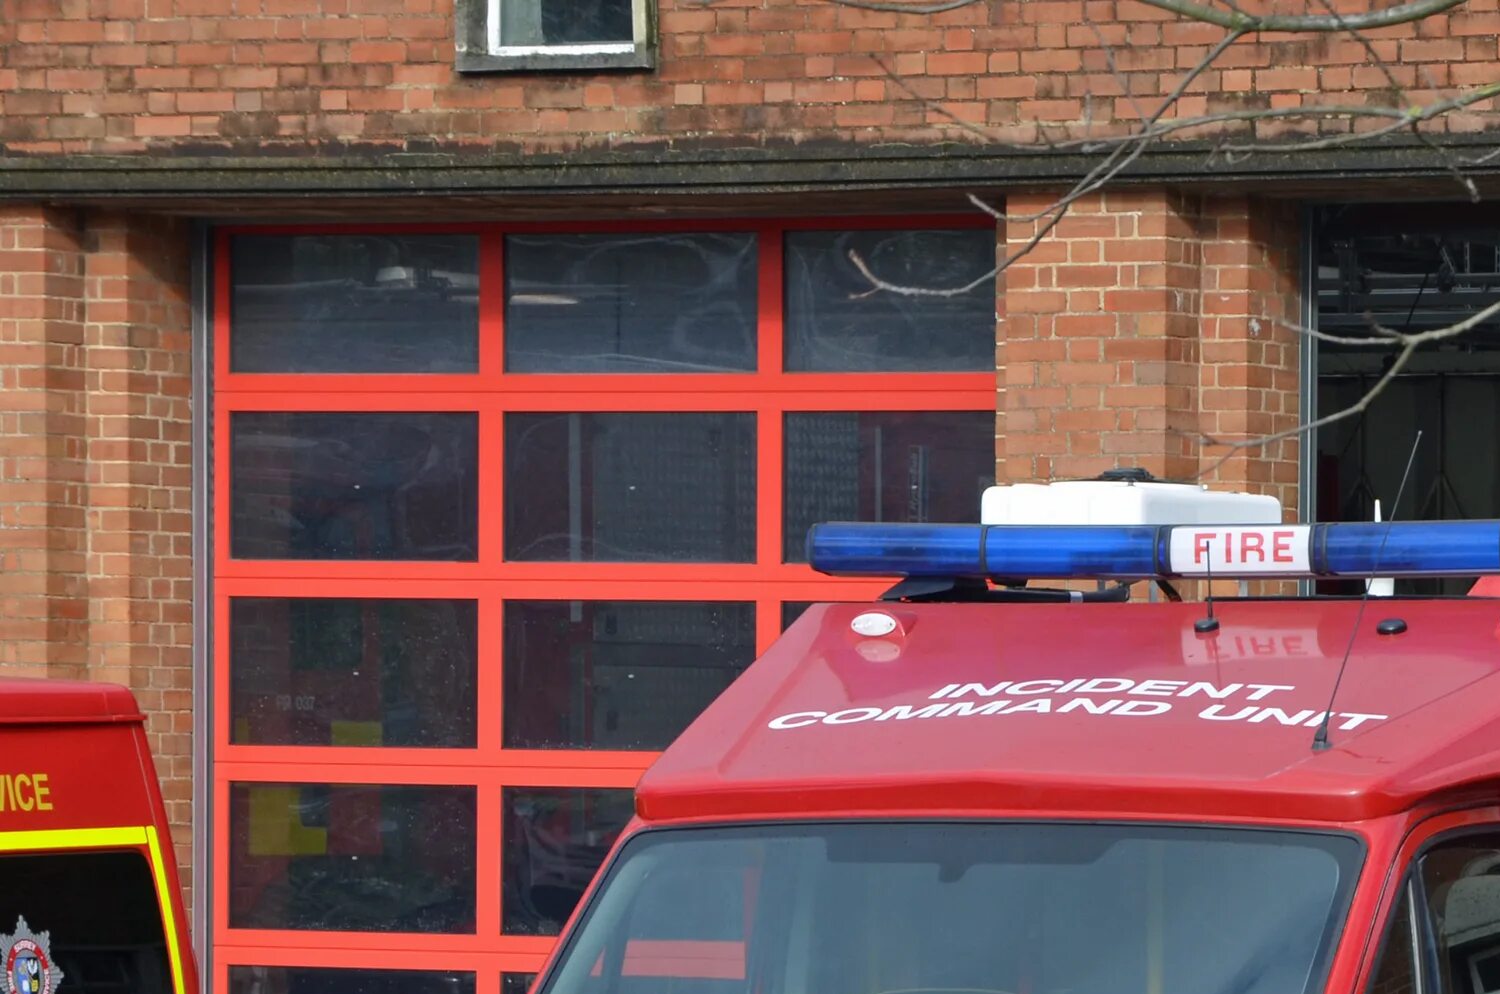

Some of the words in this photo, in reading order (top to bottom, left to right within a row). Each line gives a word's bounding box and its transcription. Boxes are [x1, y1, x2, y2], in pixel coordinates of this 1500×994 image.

[1194, 531, 1295, 564] FIRE
[927, 678, 1296, 699] INCIDENT
[768, 697, 1173, 731] COMMAND
[1197, 703, 1389, 732] UNIT
